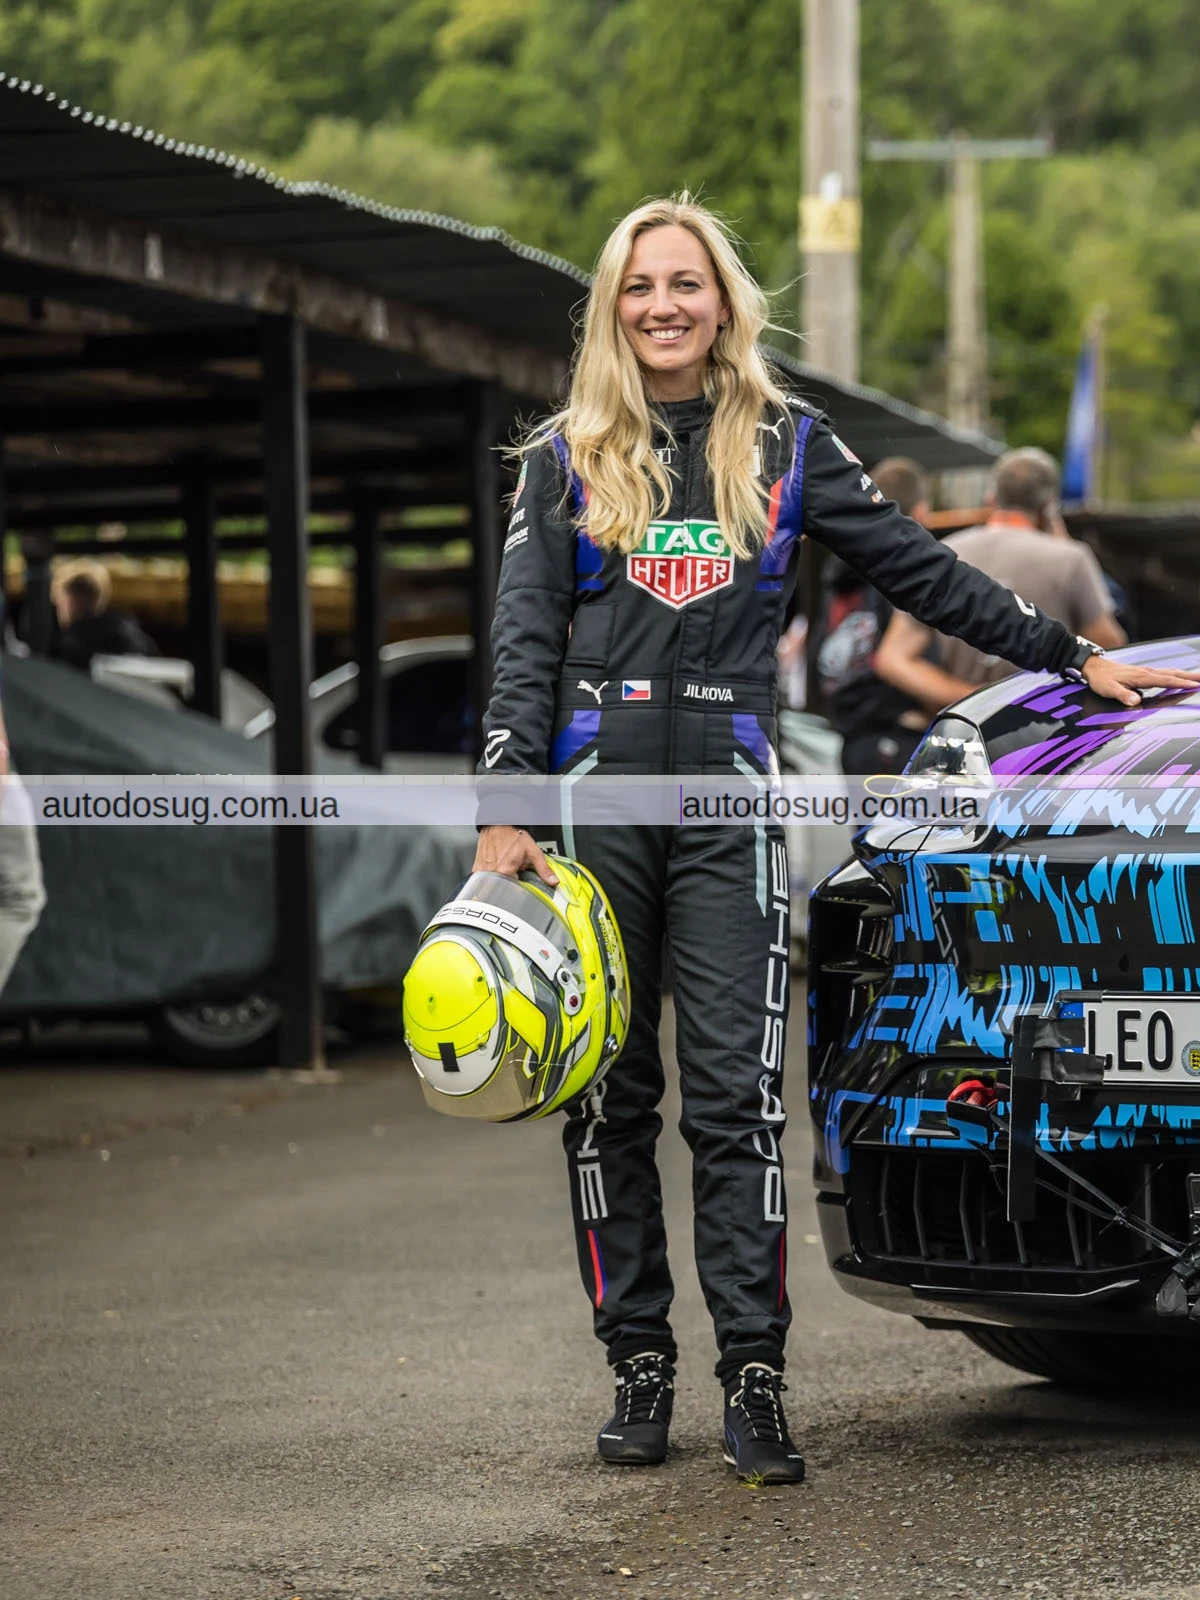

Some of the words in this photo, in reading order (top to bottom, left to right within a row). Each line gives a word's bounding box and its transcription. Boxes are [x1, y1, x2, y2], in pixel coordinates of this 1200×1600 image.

[646, 526, 726, 553] TAG
[634, 559, 727, 601] HEUER
[683, 684, 734, 701] JILKOVA
[753, 842, 790, 1222] PORSCHE
[1087, 1010, 1173, 1071] LEO
